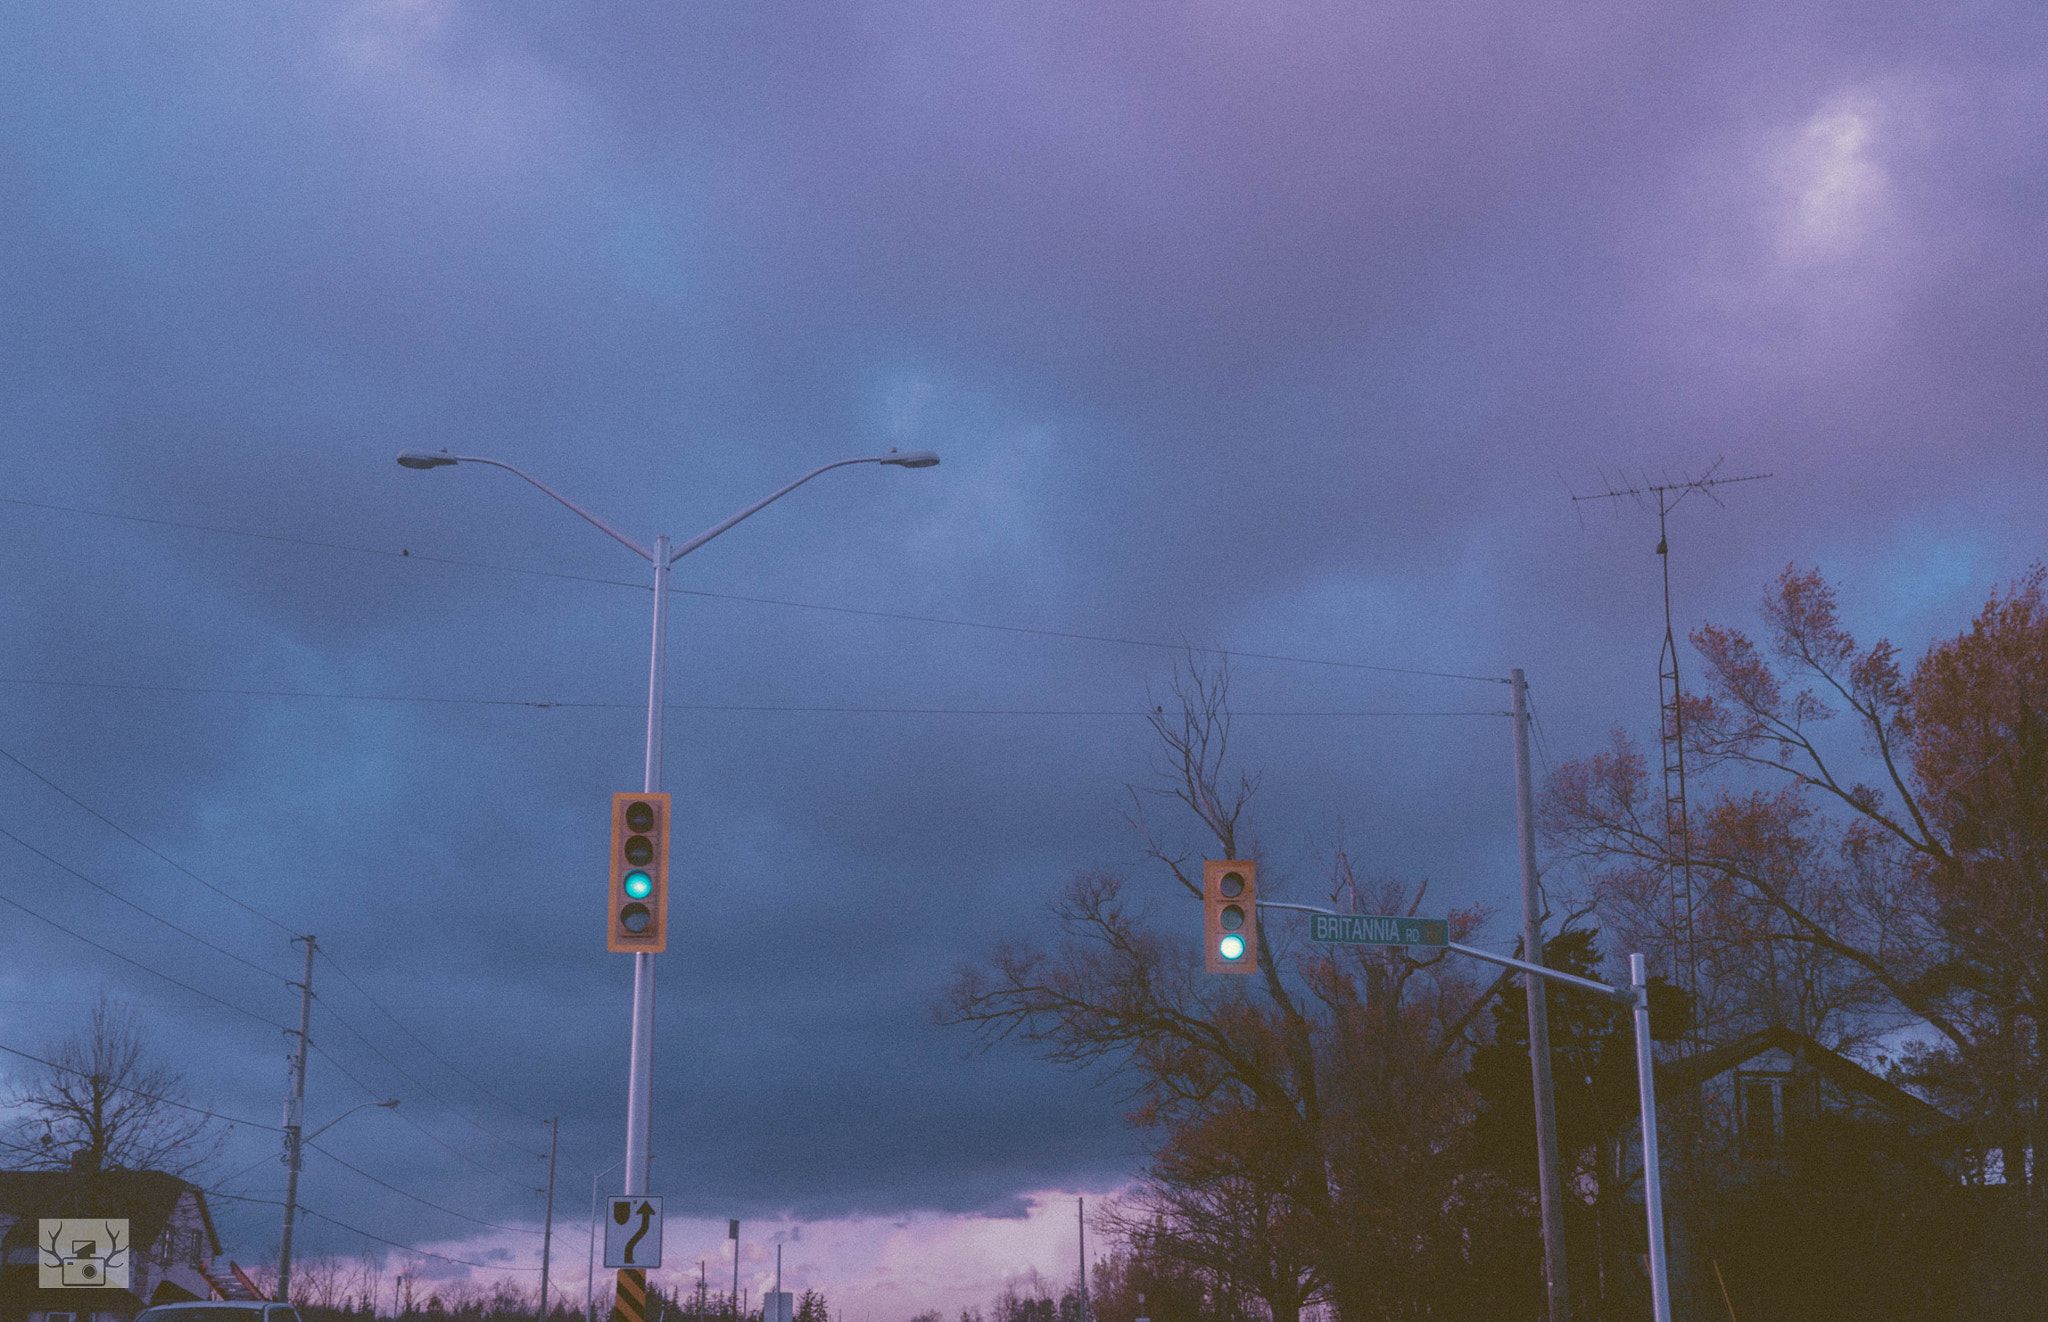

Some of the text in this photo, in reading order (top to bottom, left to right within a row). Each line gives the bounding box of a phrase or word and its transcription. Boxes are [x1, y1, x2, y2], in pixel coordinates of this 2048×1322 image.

[1317, 916, 1438, 942] BRITANNIA RD 6
